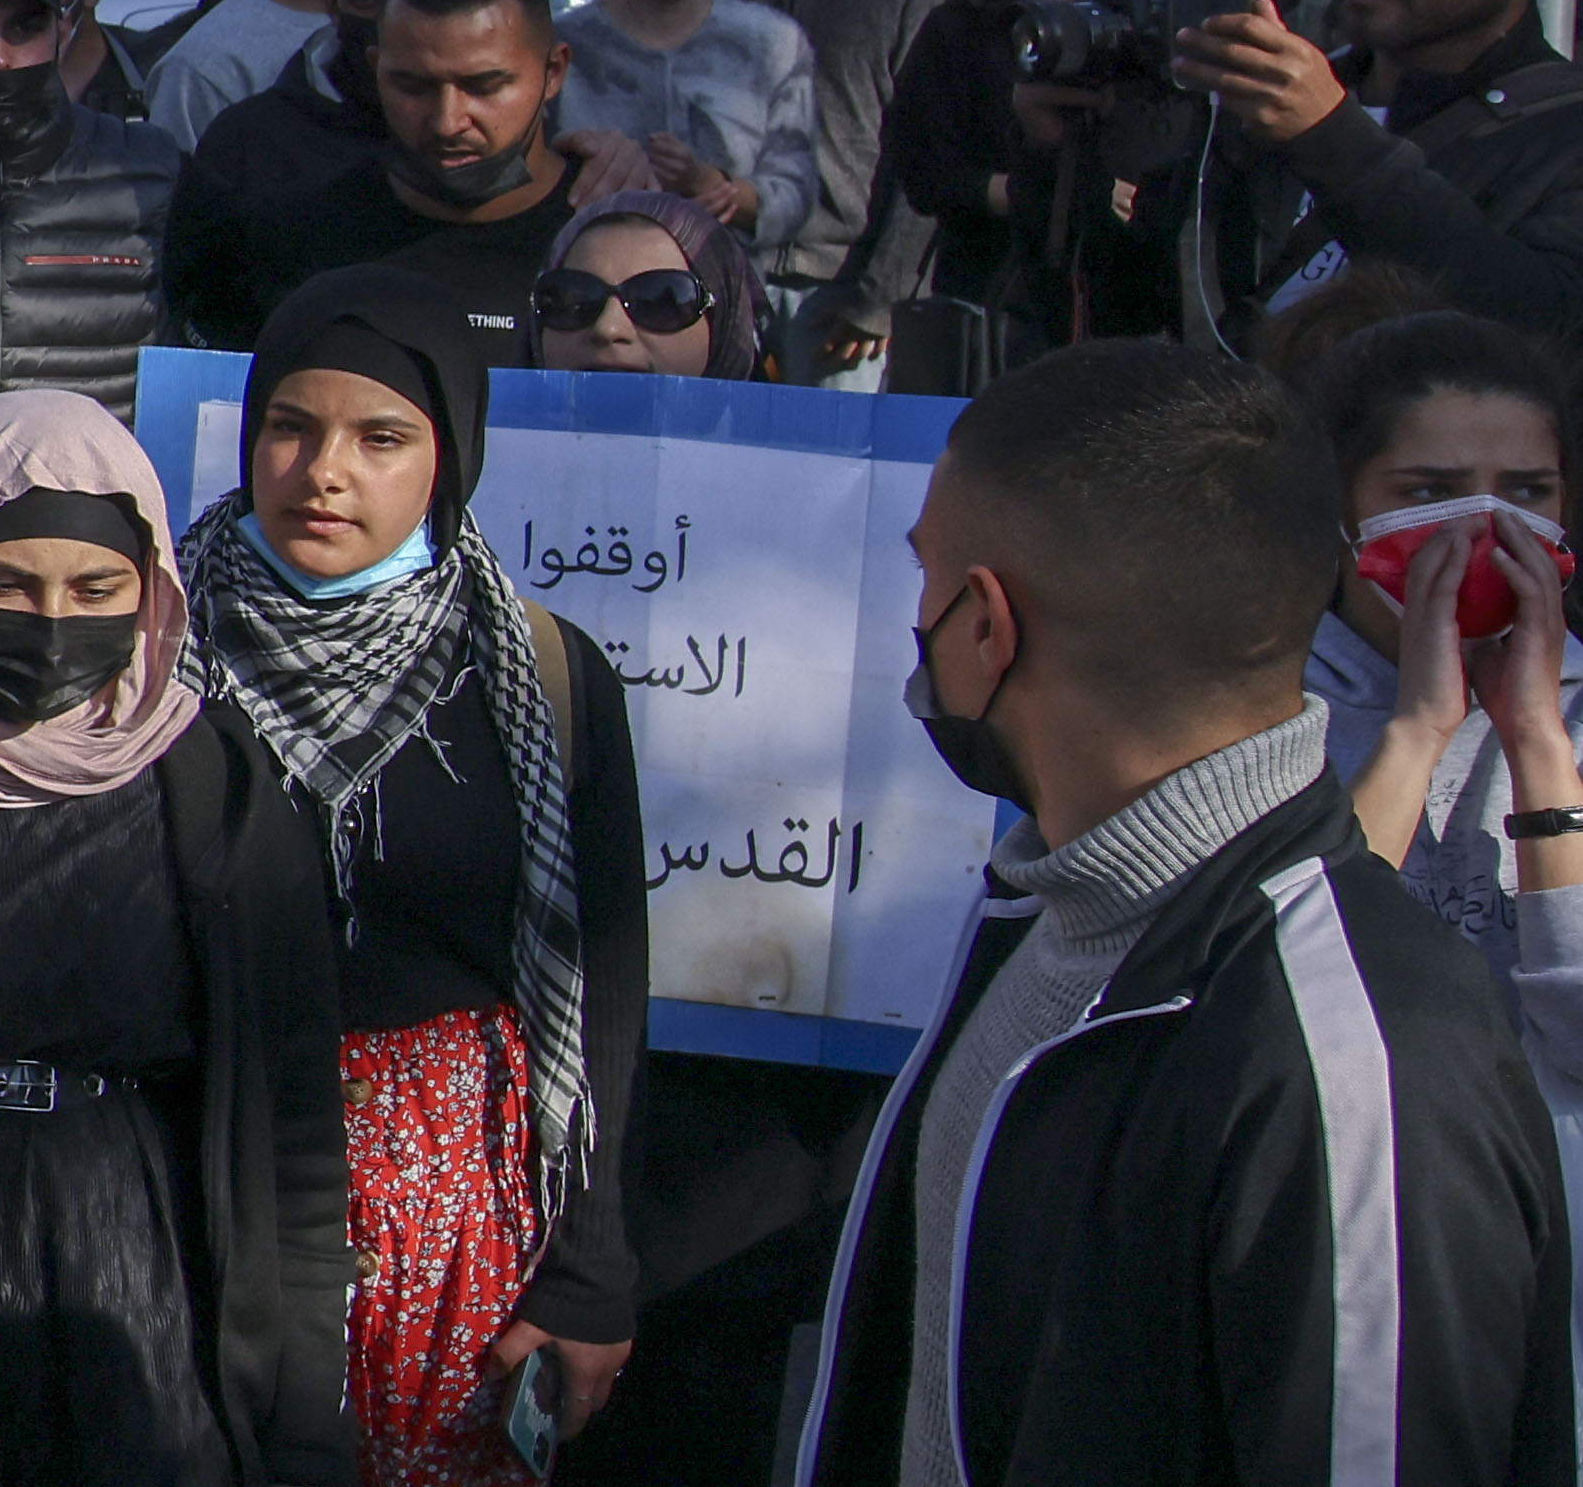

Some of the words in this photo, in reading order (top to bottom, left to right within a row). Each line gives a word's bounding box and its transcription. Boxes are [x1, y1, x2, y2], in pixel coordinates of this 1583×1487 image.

[92, 256, 140, 266] PRADA
[523, 514, 692, 594] أوقفوا
[646, 816, 864, 895] القدس
